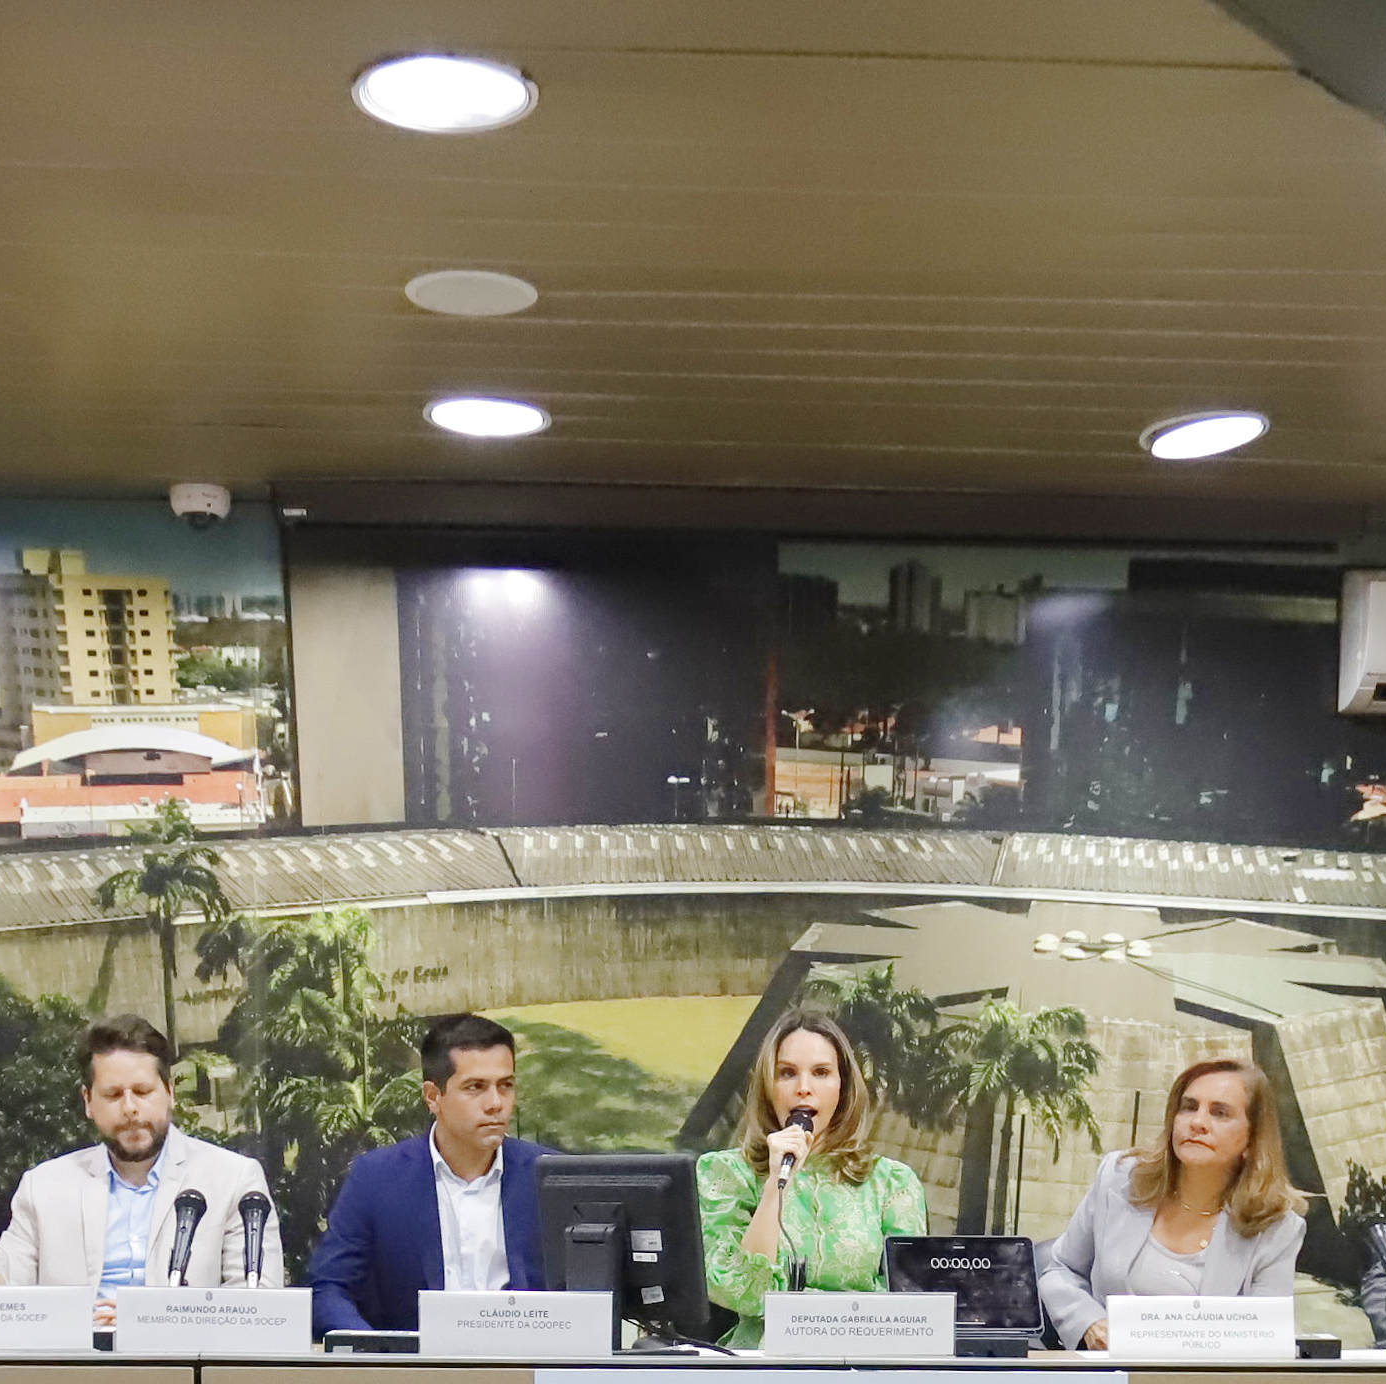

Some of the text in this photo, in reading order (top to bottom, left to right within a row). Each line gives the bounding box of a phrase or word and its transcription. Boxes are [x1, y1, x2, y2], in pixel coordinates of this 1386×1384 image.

[166, 1304, 258, 1314] RAIMUNDO ARAÚJO
[479, 1308, 549, 1318] CLÁUDIO LEITE
[0, 1314, 13, 1322] DA
[15, 1314, 48, 1322] SOCEP
[137, 1315, 287, 1326] MEMBRO DA DIREÇÃO DA SOCEP
[791, 1315, 927, 1324] DEPUTADA GABRIELLA AGUIAR
[1141, 1311, 1258, 1321] DRA. ANA CLÁUDIA UCHOA
[457, 1320, 572, 1329] PRESIDENTE DA COOPEC
[784, 1327, 934, 1337] AUTORA DO REQUERIMENTO
[1130, 1329, 1275, 1339] REPRESENTANTE DO MINISTÉRIO
[1182, 1339, 1221, 1349] PÚBLICO
